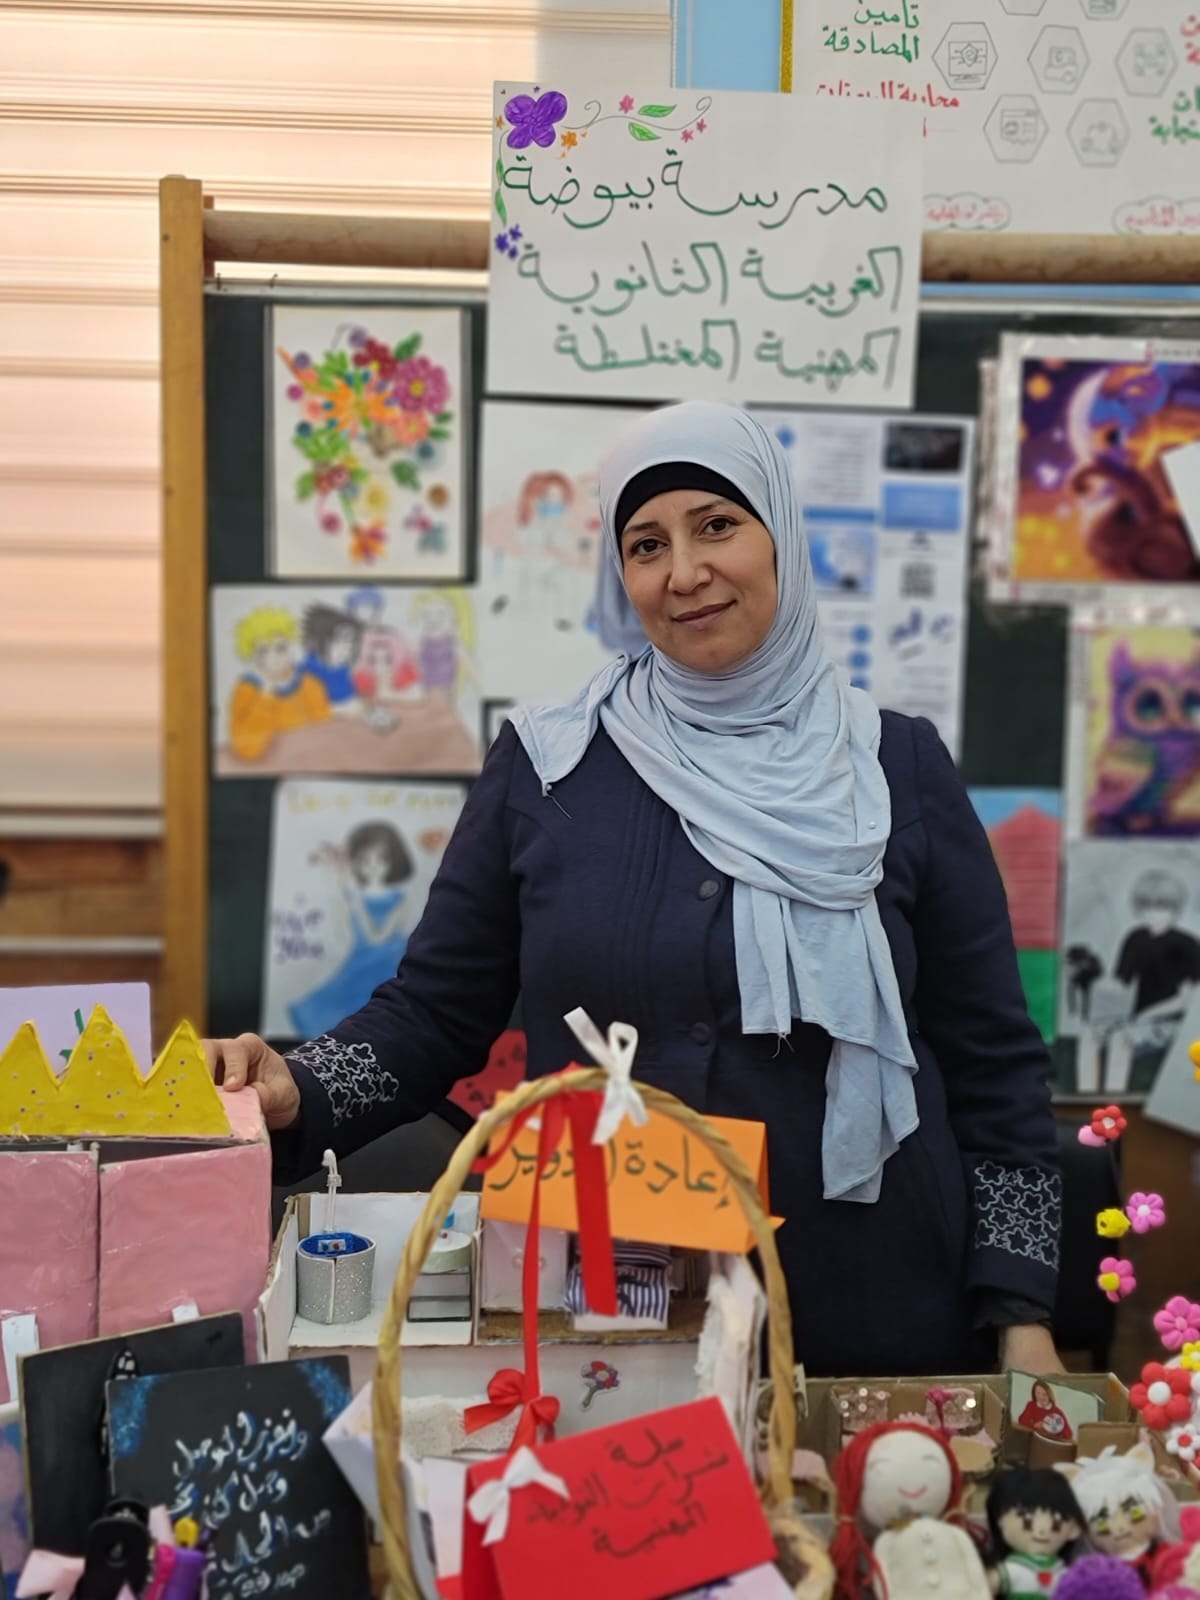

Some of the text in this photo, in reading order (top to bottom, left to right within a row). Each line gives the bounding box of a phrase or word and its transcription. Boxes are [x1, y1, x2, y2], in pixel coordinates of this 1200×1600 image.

[821, 25, 920, 63] المصادقة
[502, 148, 888, 230] مدرسة بيوضة
[517, 241, 903, 318] الغربية الثانوية
[553, 318, 901, 393] المهنية المختلطة
